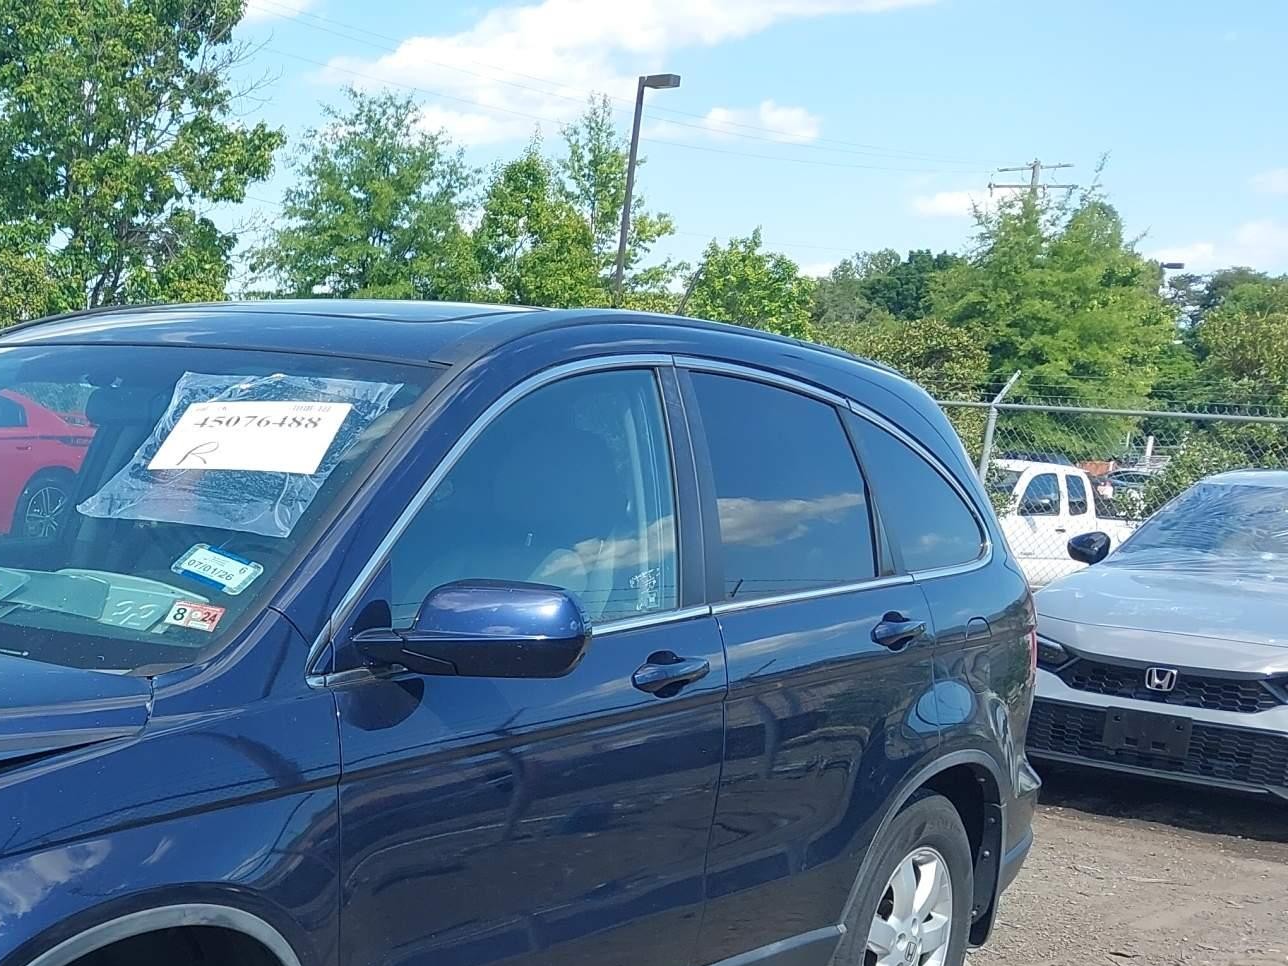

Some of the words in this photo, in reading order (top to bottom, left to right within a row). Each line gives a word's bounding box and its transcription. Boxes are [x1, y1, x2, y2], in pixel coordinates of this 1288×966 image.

[193, 415, 323, 429] 45076488
[187, 559, 235, 581] 07/01/26
[172, 607, 187, 621] 8
[199, 611, 218, 623] 24
